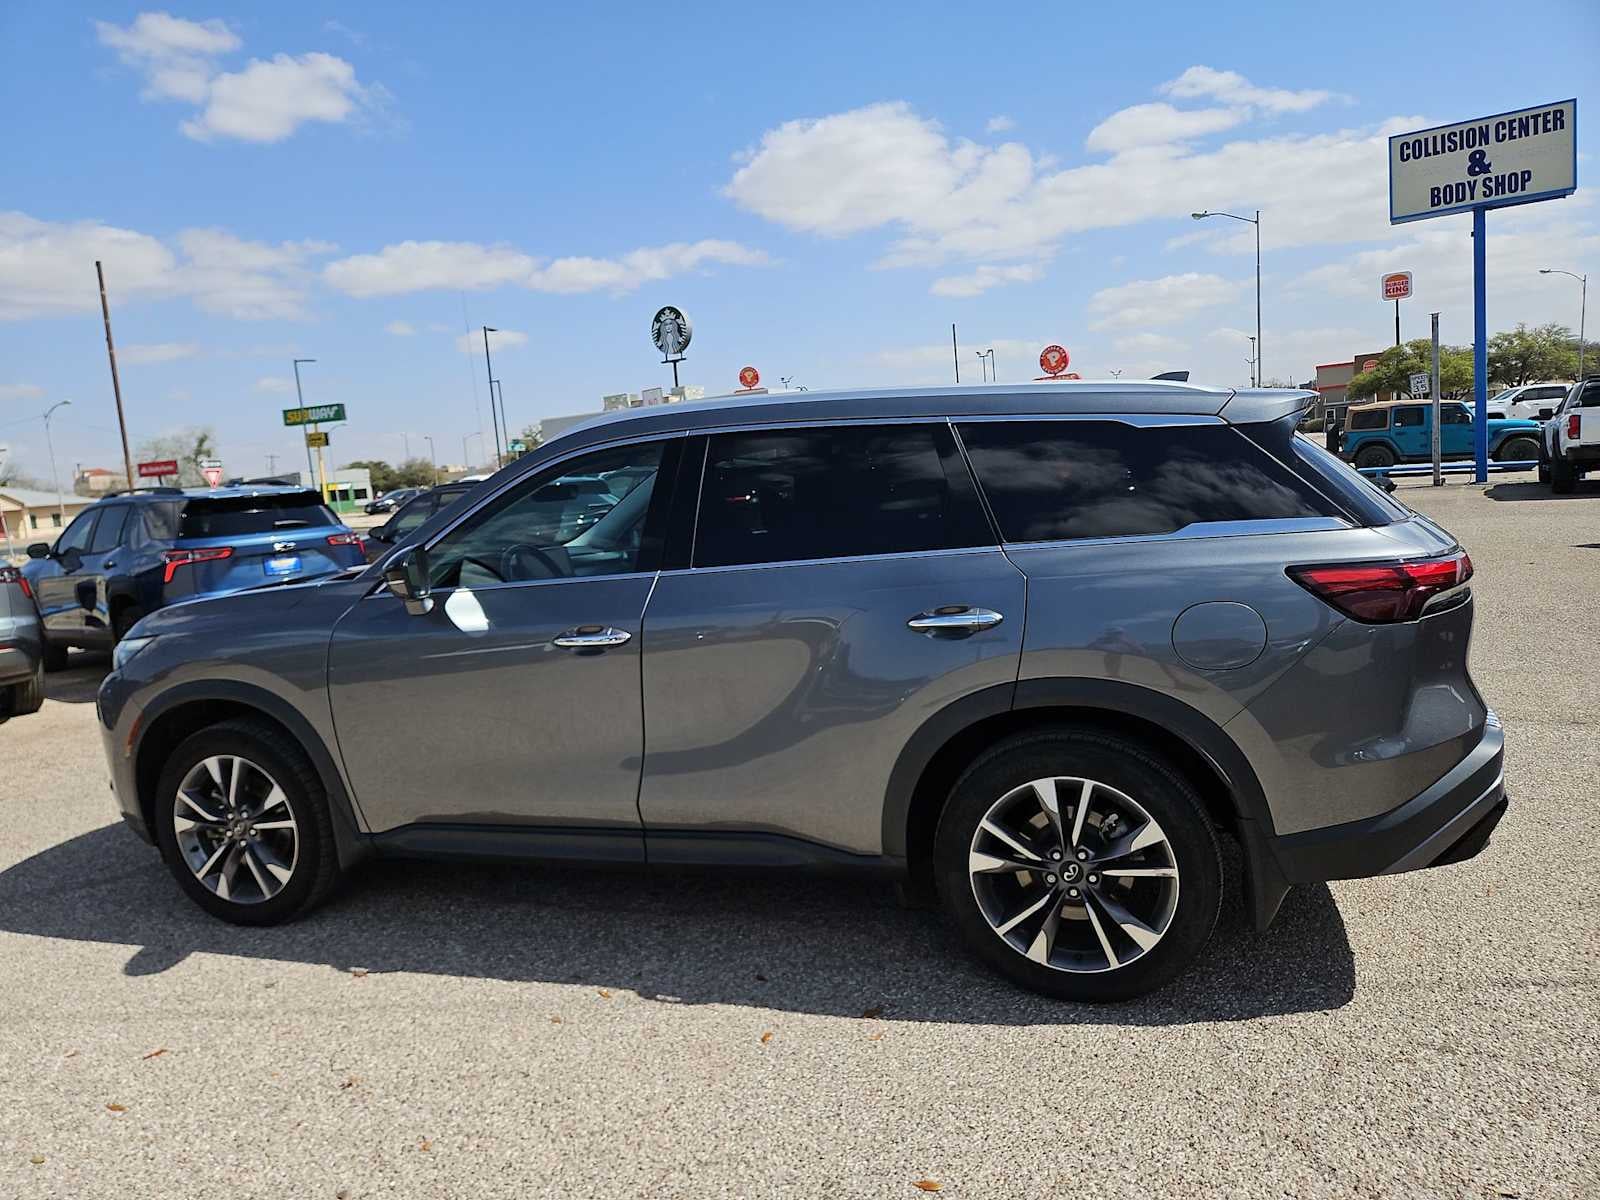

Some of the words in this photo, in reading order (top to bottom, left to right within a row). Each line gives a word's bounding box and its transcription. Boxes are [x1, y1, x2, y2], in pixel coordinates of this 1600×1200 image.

[1400, 125, 1489, 162] COLLISION
[1495, 109, 1565, 144] CENTER
[1467, 149, 1492, 177] &
[1430, 179, 1478, 208] BODY
[1482, 169, 1532, 199] SHOP
[1385, 285, 1409, 294] KING
[1413, 385, 1427, 393] 35
